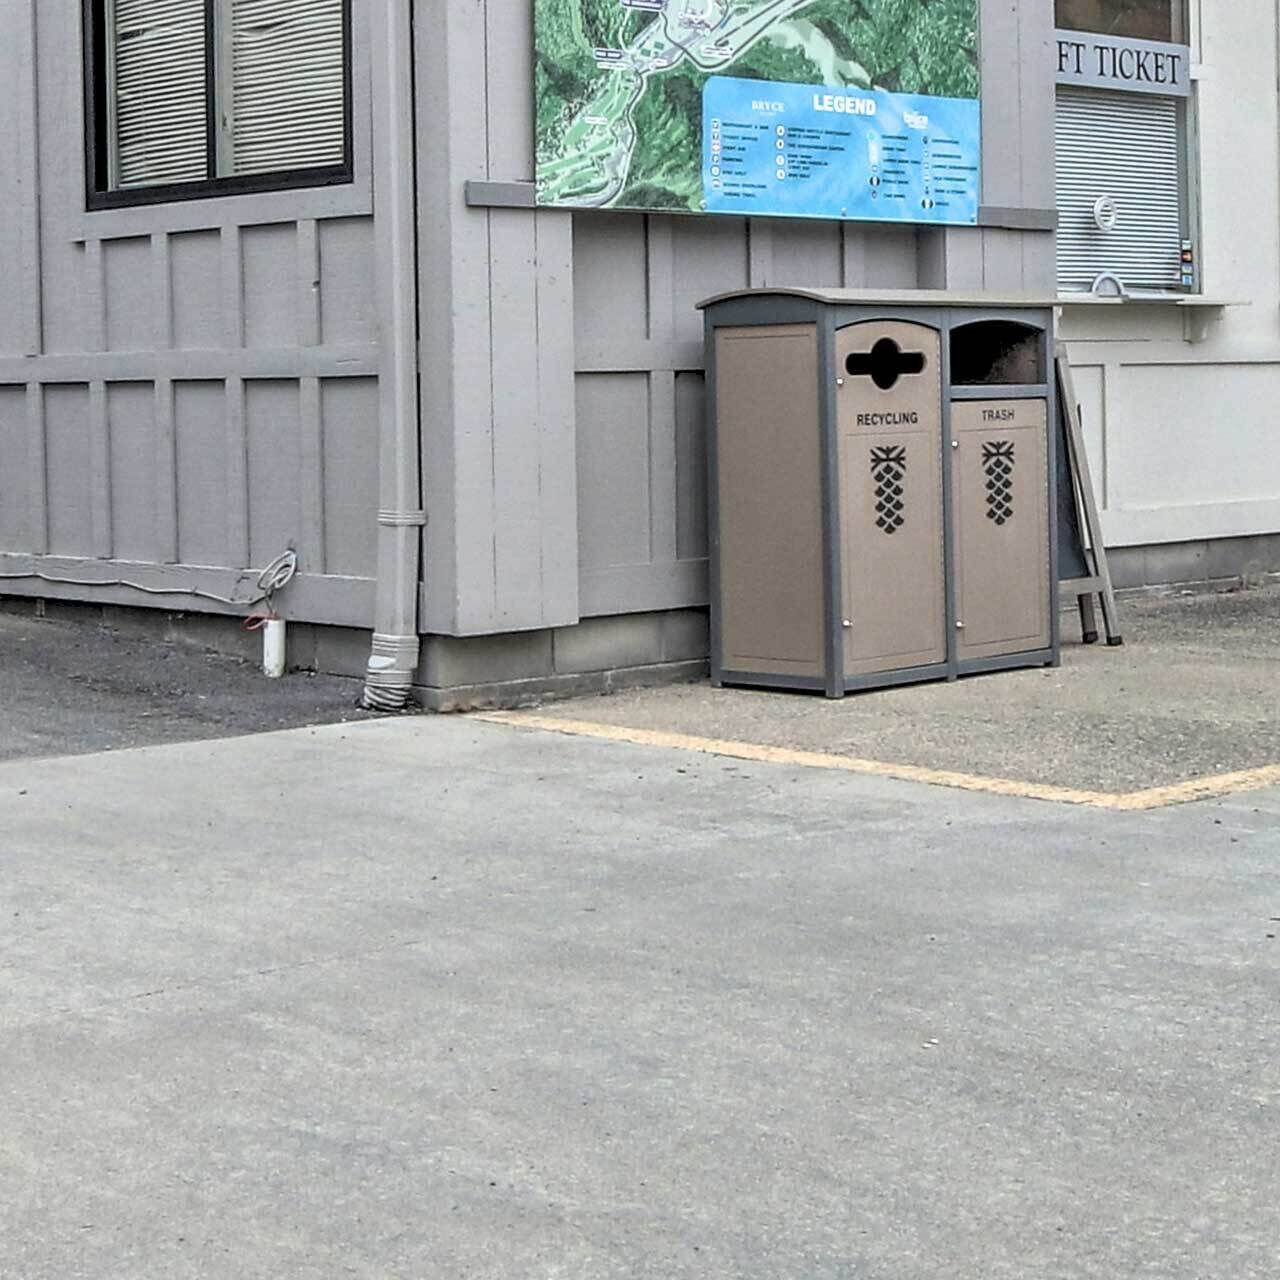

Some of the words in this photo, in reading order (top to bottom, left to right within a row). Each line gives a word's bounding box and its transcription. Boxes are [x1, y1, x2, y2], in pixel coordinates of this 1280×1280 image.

[1094, 45, 1181, 84] TICKET
[813, 94, 876, 116] LEGEND
[856, 411, 918, 426] RECYCLING
[982, 409, 1015, 422] TRASH
